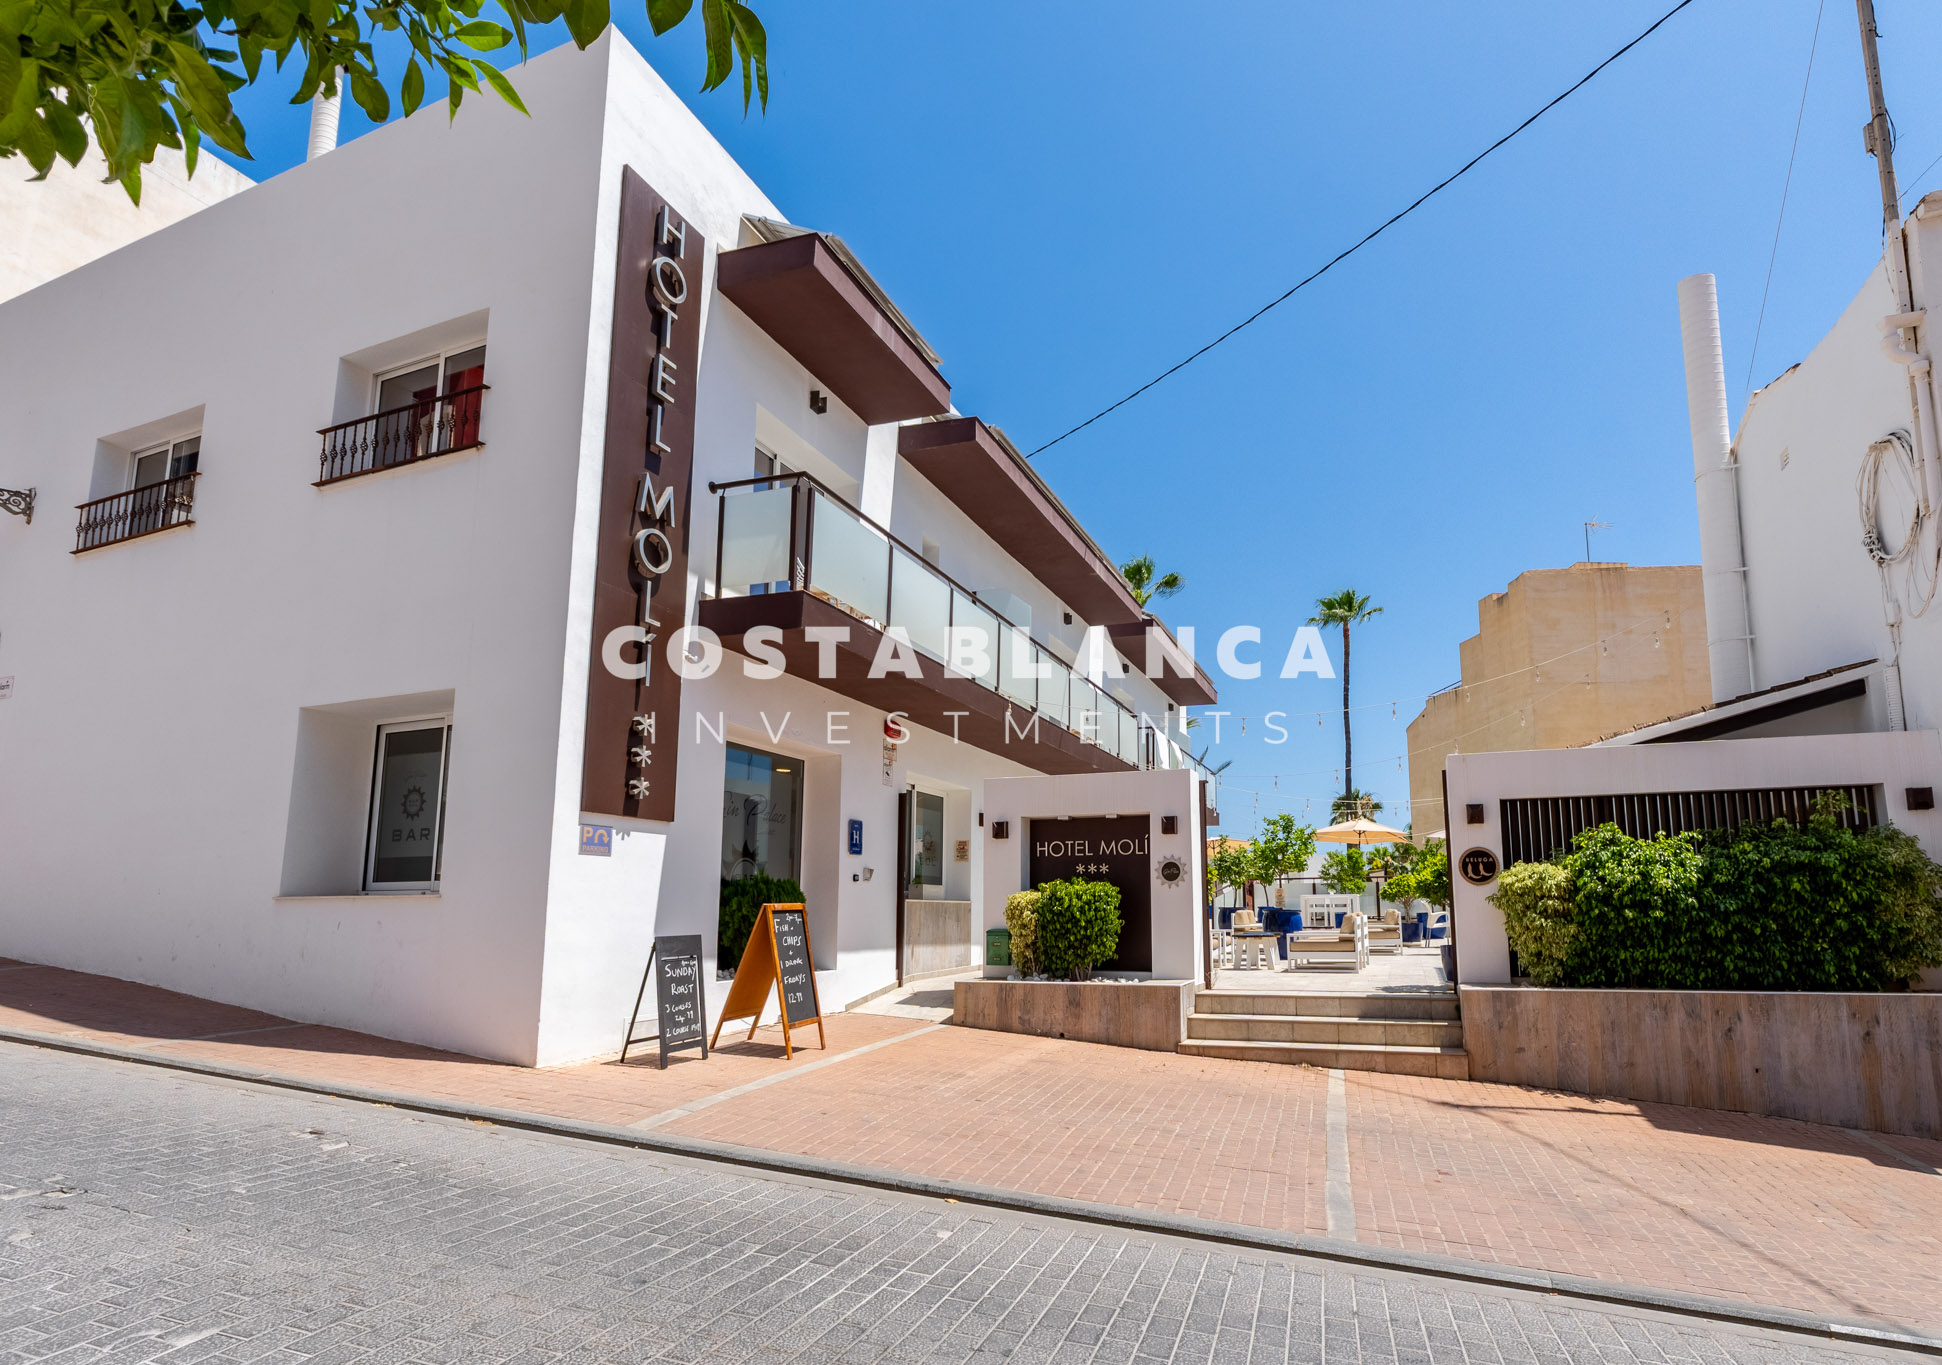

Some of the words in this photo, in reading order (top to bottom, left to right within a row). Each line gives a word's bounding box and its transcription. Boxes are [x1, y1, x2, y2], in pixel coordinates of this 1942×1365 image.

[650, 204, 687, 454] HOTEL
[392, 827, 431, 842] BAR
[583, 827, 594, 842] P
[852, 830, 860, 844] H
[1036, 840, 1093, 857] HOTEL
[1100, 834, 1149, 856] MOLÍ
[782, 936, 802, 946] CHIPS
[665, 963, 696, 981] SUNDAY
[671, 983, 694, 996] ROAST
[665, 1004, 670, 1013] 3
[666, 1028, 671, 1037] 2
